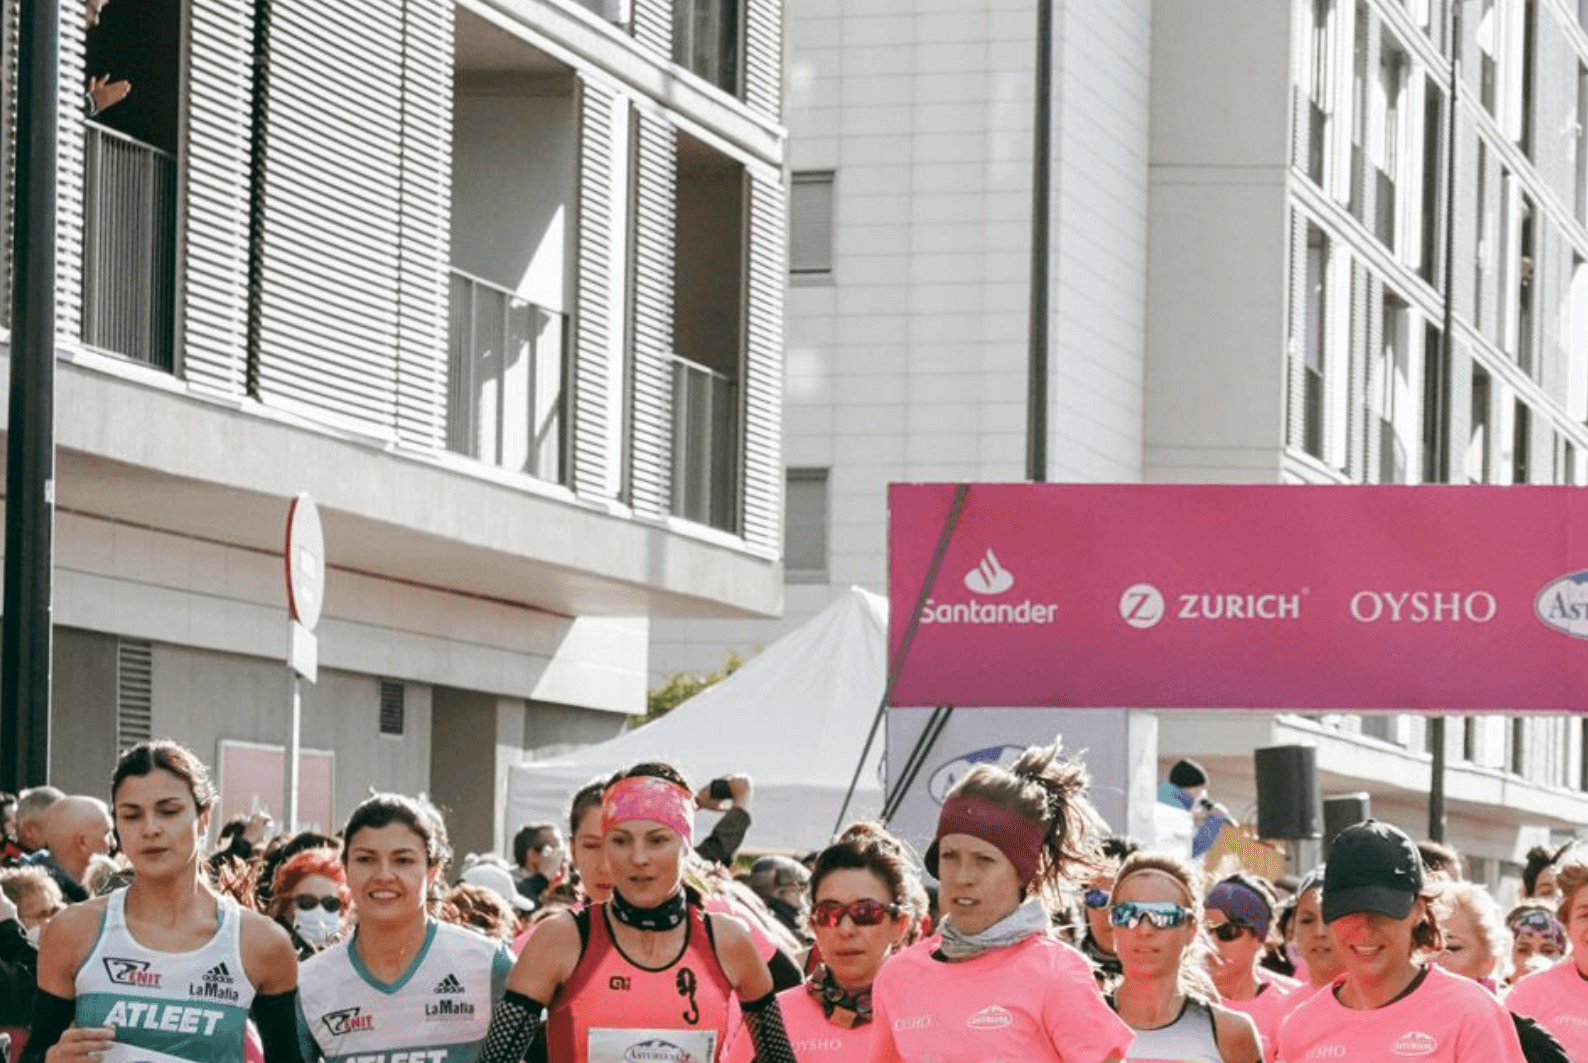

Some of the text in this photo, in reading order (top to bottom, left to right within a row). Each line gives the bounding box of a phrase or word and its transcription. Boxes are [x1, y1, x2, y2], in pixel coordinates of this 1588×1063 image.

[919, 598, 1058, 625] Santander
[1179, 594, 1300, 620] ZURICH
[1349, 591, 1498, 623] OYSHO
[103, 1000, 225, 1036] ATLEET
